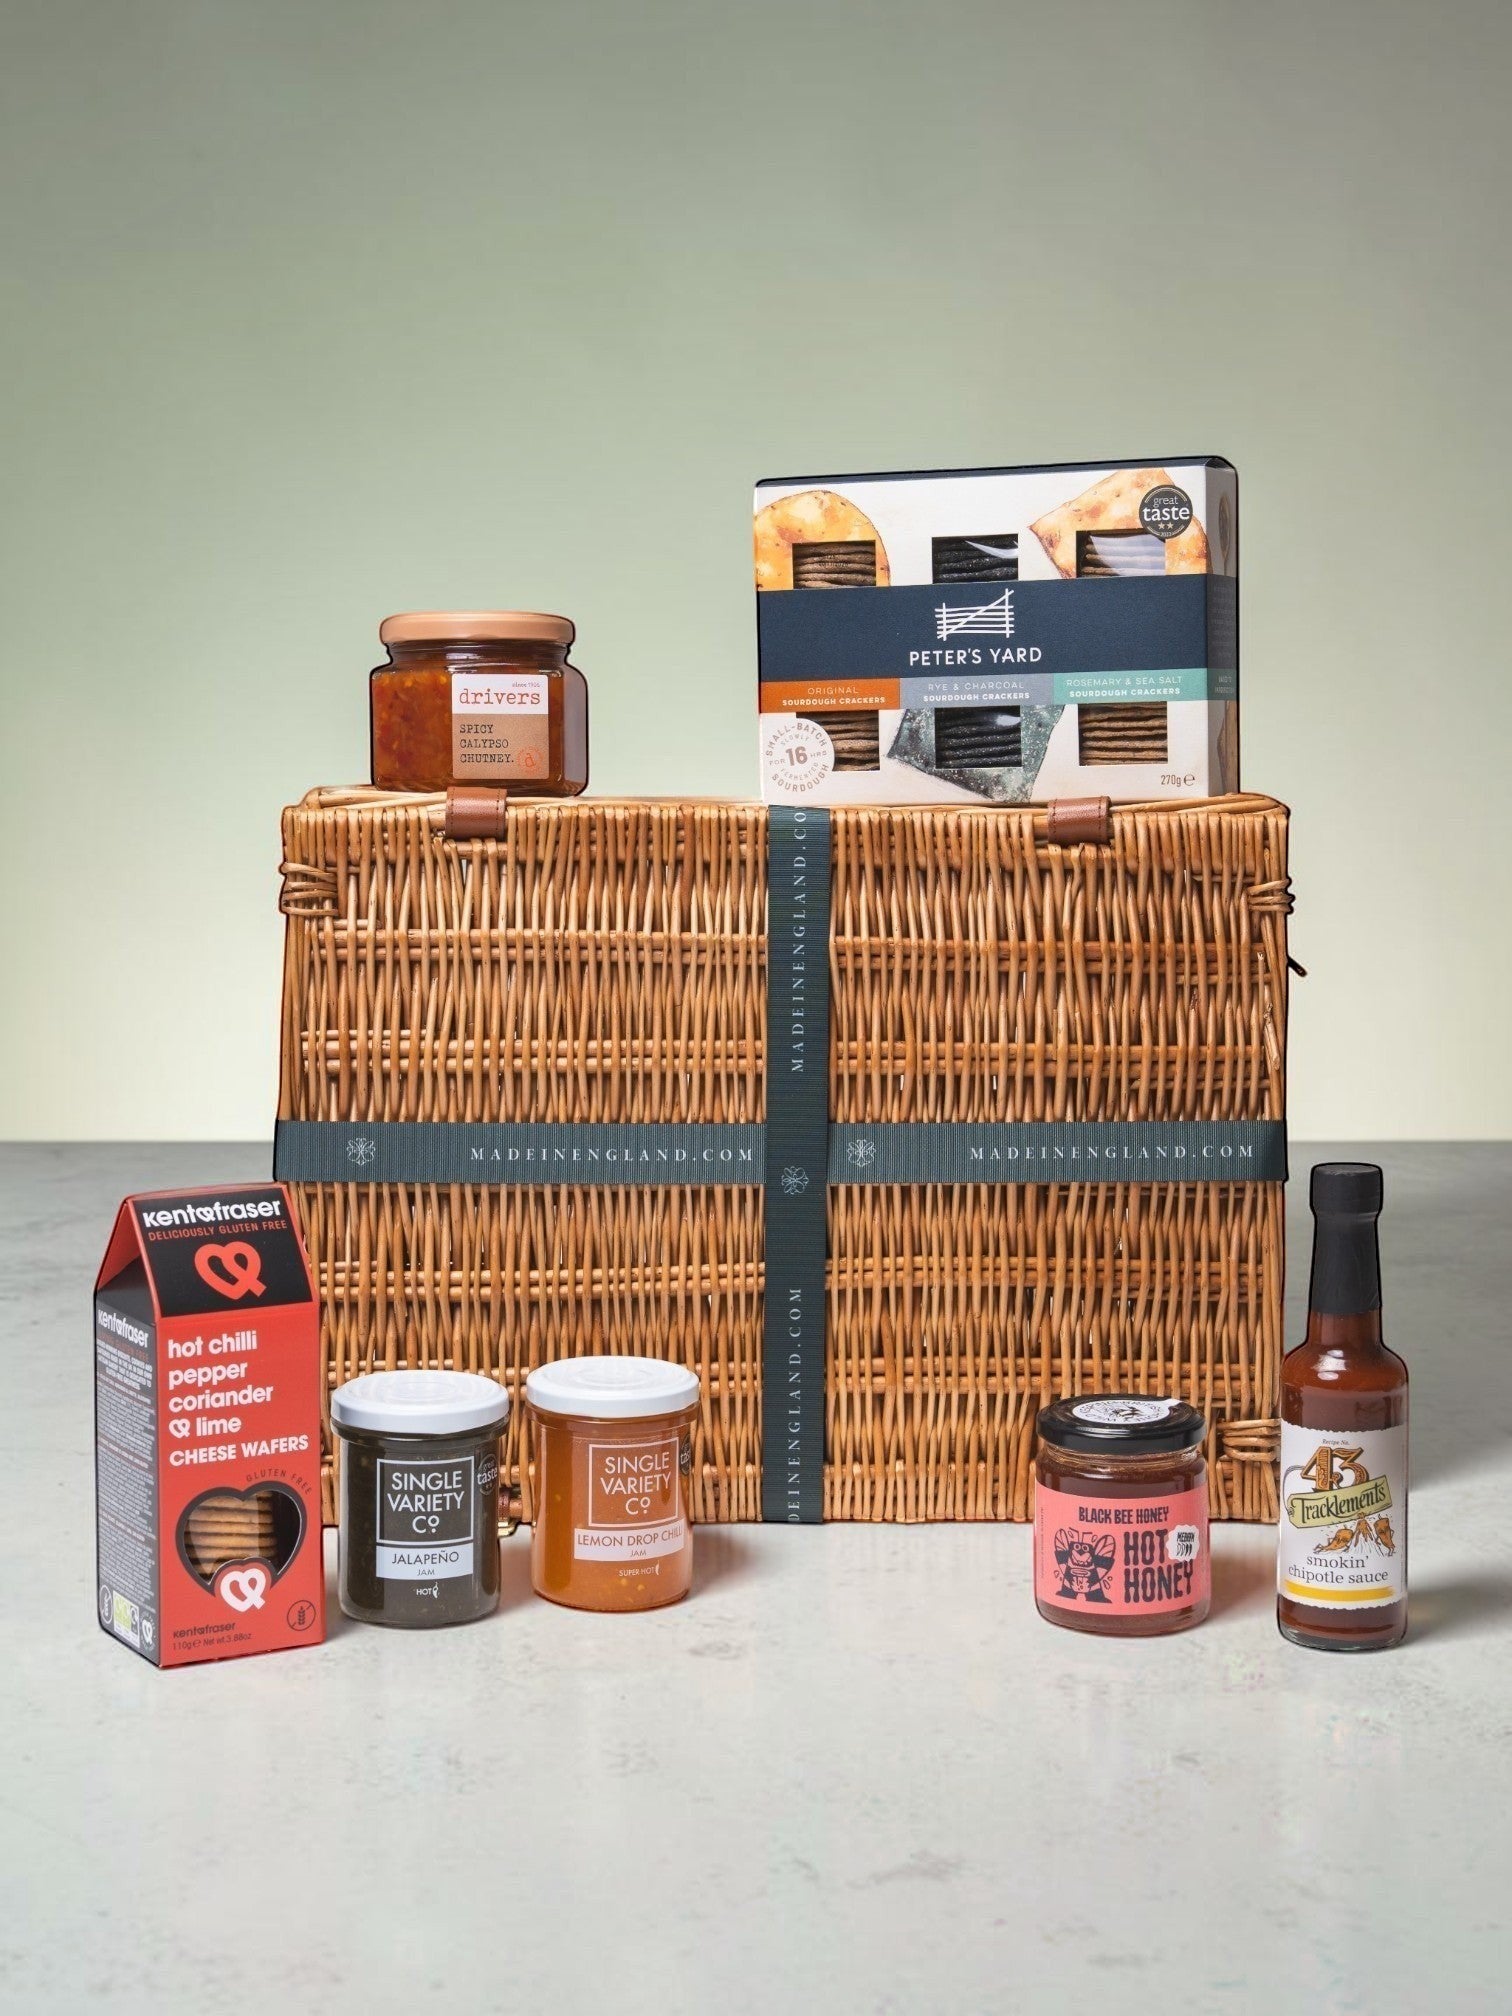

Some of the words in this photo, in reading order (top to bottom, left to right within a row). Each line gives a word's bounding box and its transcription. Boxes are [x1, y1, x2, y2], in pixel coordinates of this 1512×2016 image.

[1153, 496, 1178, 508] great
[1142, 506, 1190, 521] taste
[909, 648, 982, 667] PETER'S
[989, 647, 1042, 664] YARD
[807, 686, 859, 695] ORIGINAL
[928, 682, 948, 691] RYE
[952, 682, 960, 690] &
[964, 681, 1024, 690] CHARCOAL
[1066, 677, 1122, 687] ROSEMARY
[1125, 677, 1132, 685] &
[1135, 677, 1155, 686] SEA
[1158, 676, 1183, 684] SALT
[459, 688, 541, 705] drivers
[782, 697, 837, 707] SOURDOUGH
[838, 696, 886, 705] CRACKERS
[923, 693, 978, 702] SOURDOUGH
[979, 691, 1030, 701] CRACKERS
[1069, 689, 1128, 698] SOURDOUGH
[1130, 687, 1181, 696] CRACKERS
[459, 724, 493, 734] SPICY
[459, 739, 509, 749] CALYPSO
[766, 722, 827, 756] SMALL-BATCH
[460, 753, 514, 763] CHUTNEY.
[785, 745, 808, 767] 16
[772, 764, 829, 792] SOURDOUGH
[1161, 774, 1181, 788] 270g
[791, 806, 807, 1072] MADEINENGLAND.CO
[470, 1147, 753, 1162] MADEINENGLAND.COM
[970, 1145, 1254, 1160] MADEINENGLAND.COM
[148, 1226, 215, 1241] DELICIOUSLY
[219, 1222, 259, 1234] GLUTEN
[263, 1219, 287, 1230] FREE
[168, 1336, 204, 1359] hot
[208, 1330, 257, 1354] chilli
[168, 1362, 248, 1391] pepper
[168, 1384, 274, 1413] coriander
[196, 1416, 242, 1437] lime
[169, 1444, 237, 1467] CHEESE
[241, 1434, 309, 1458] WAFERS
[604, 1451, 670, 1474] SINGLE
[246, 1468, 287, 1482] GLUTEN
[291, 1473, 312, 1495] FREE
[391, 1470, 462, 1491] SINGLE
[600, 1472, 671, 1496] VARIETY
[387, 1491, 465, 1512] VARIETY
[1292, 1482, 1386, 1524] Tracklements
[1078, 1506, 1112, 1523] BLACK
[1114, 1509, 1134, 1524] BEE
[1136, 1505, 1169, 1523] HONEY
[577, 1534, 623, 1547] LEMON
[627, 1533, 659, 1546] DROP
[1124, 1528, 1168, 1566] HOT
[392, 1550, 459, 1565] JALAPEÑO
[1306, 1555, 1369, 1569] smokin'
[619, 1568, 640, 1577] SUPER
[1124, 1558, 1194, 1603] HONEY
[1288, 1565, 1344, 1584] chipotle
[1348, 1570, 1389, 1583] sauce
[416, 1587, 432, 1595] HOT
